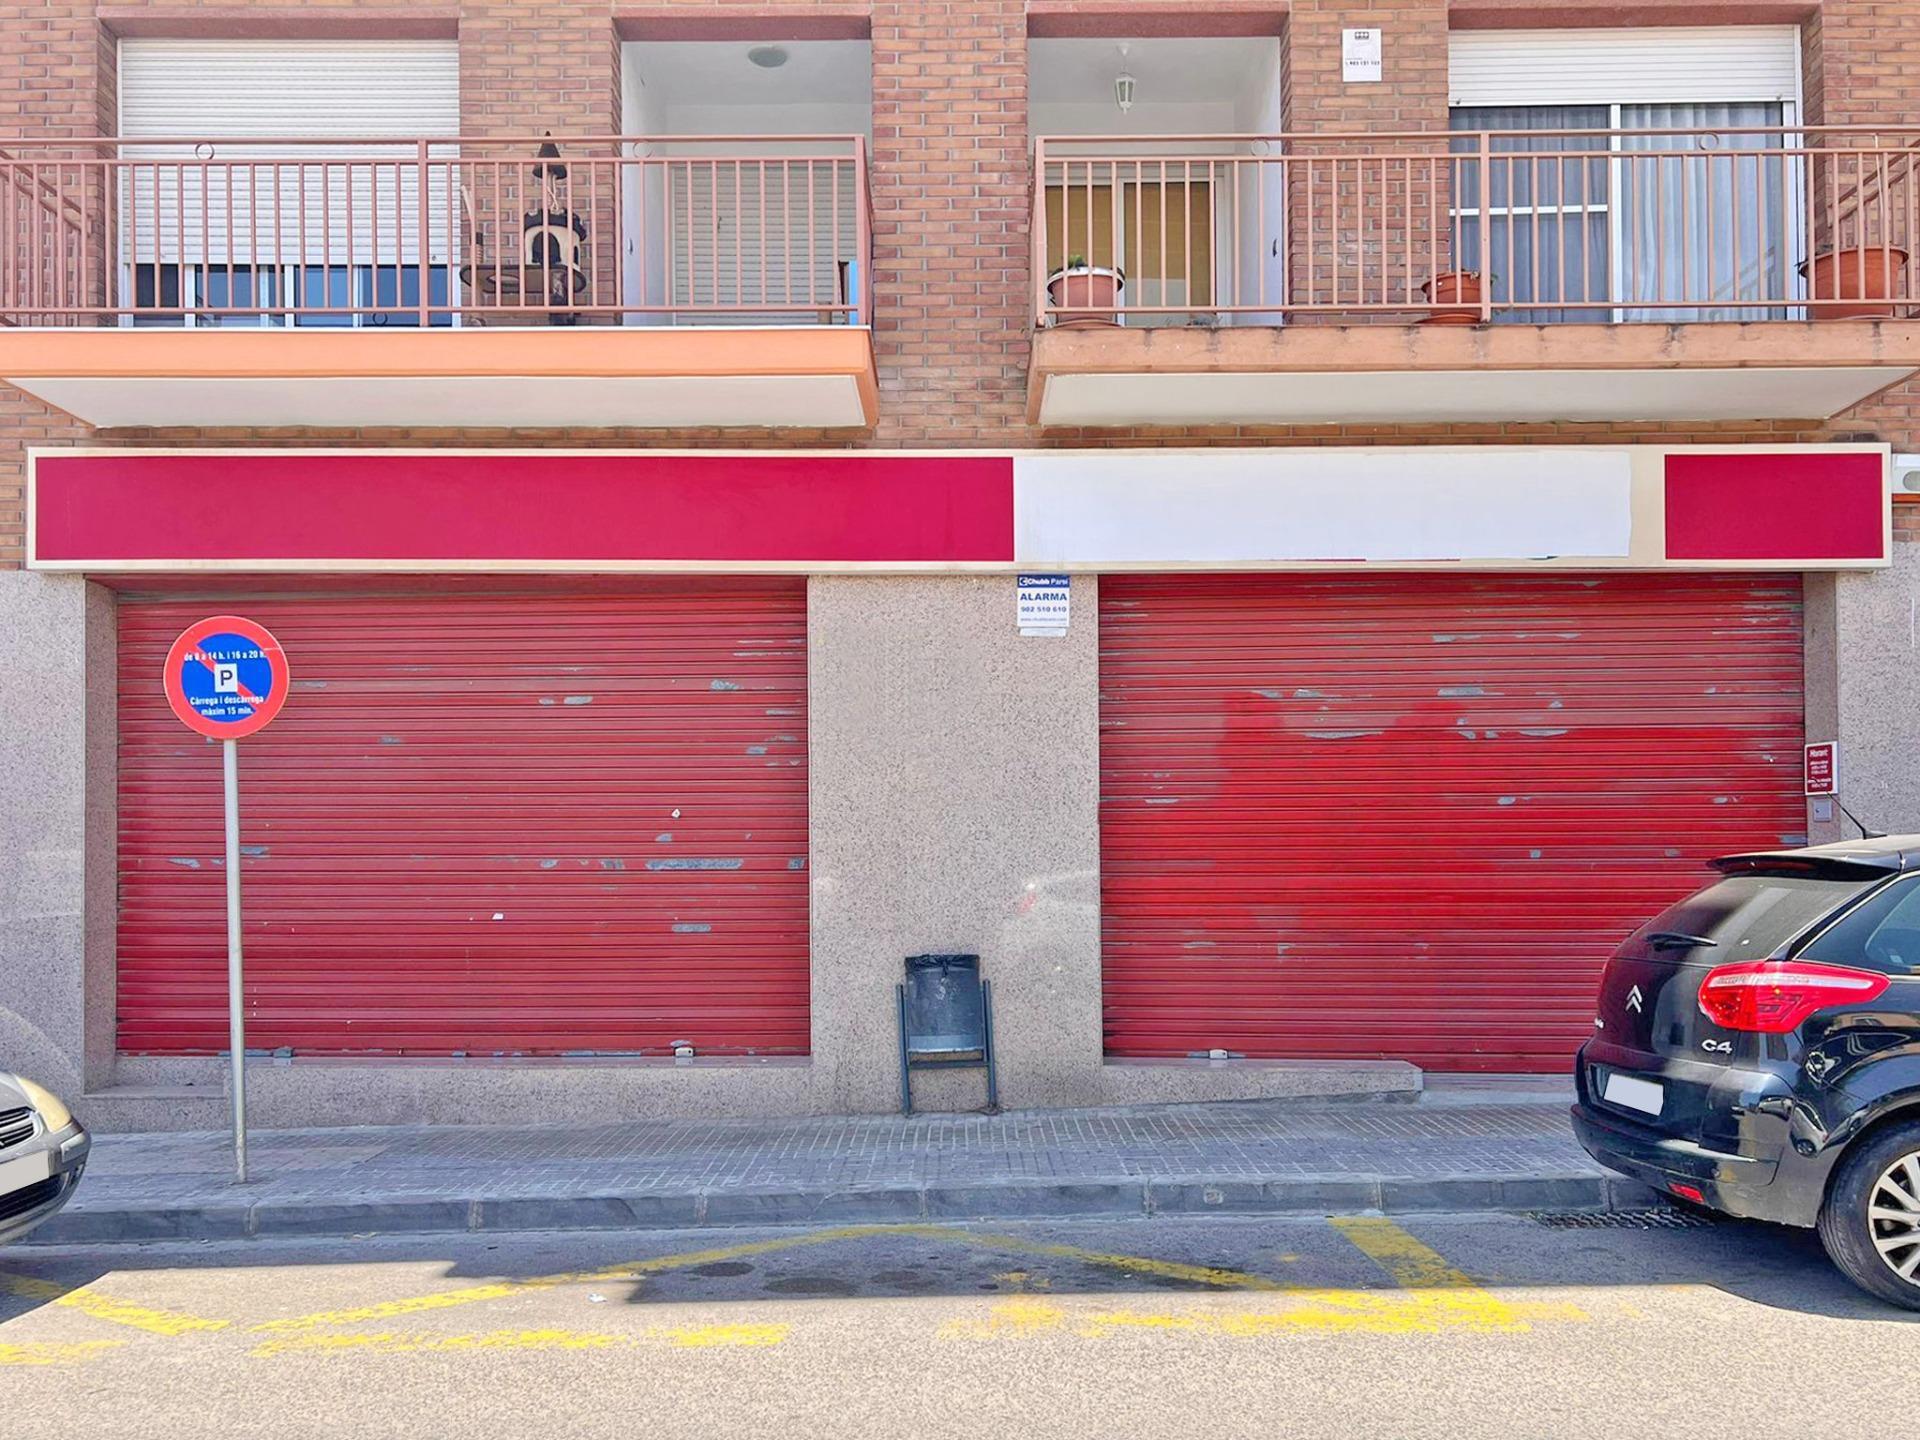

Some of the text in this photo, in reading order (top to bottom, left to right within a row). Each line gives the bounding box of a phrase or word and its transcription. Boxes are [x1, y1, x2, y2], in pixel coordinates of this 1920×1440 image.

[1020, 592, 1067, 601] ALARMA
[184, 652, 193, 661] de
[208, 651, 217, 660] 14
[231, 651, 241, 660] 16
[242, 651, 248, 659] a
[248, 650, 258, 659] 20
[220, 670, 233, 686] P
[190, 696, 218, 706] Càrrega
[224, 695, 264, 705] descàrrega
[226, 706, 237, 715] 15
[1701, 1039, 1733, 1054] C4
